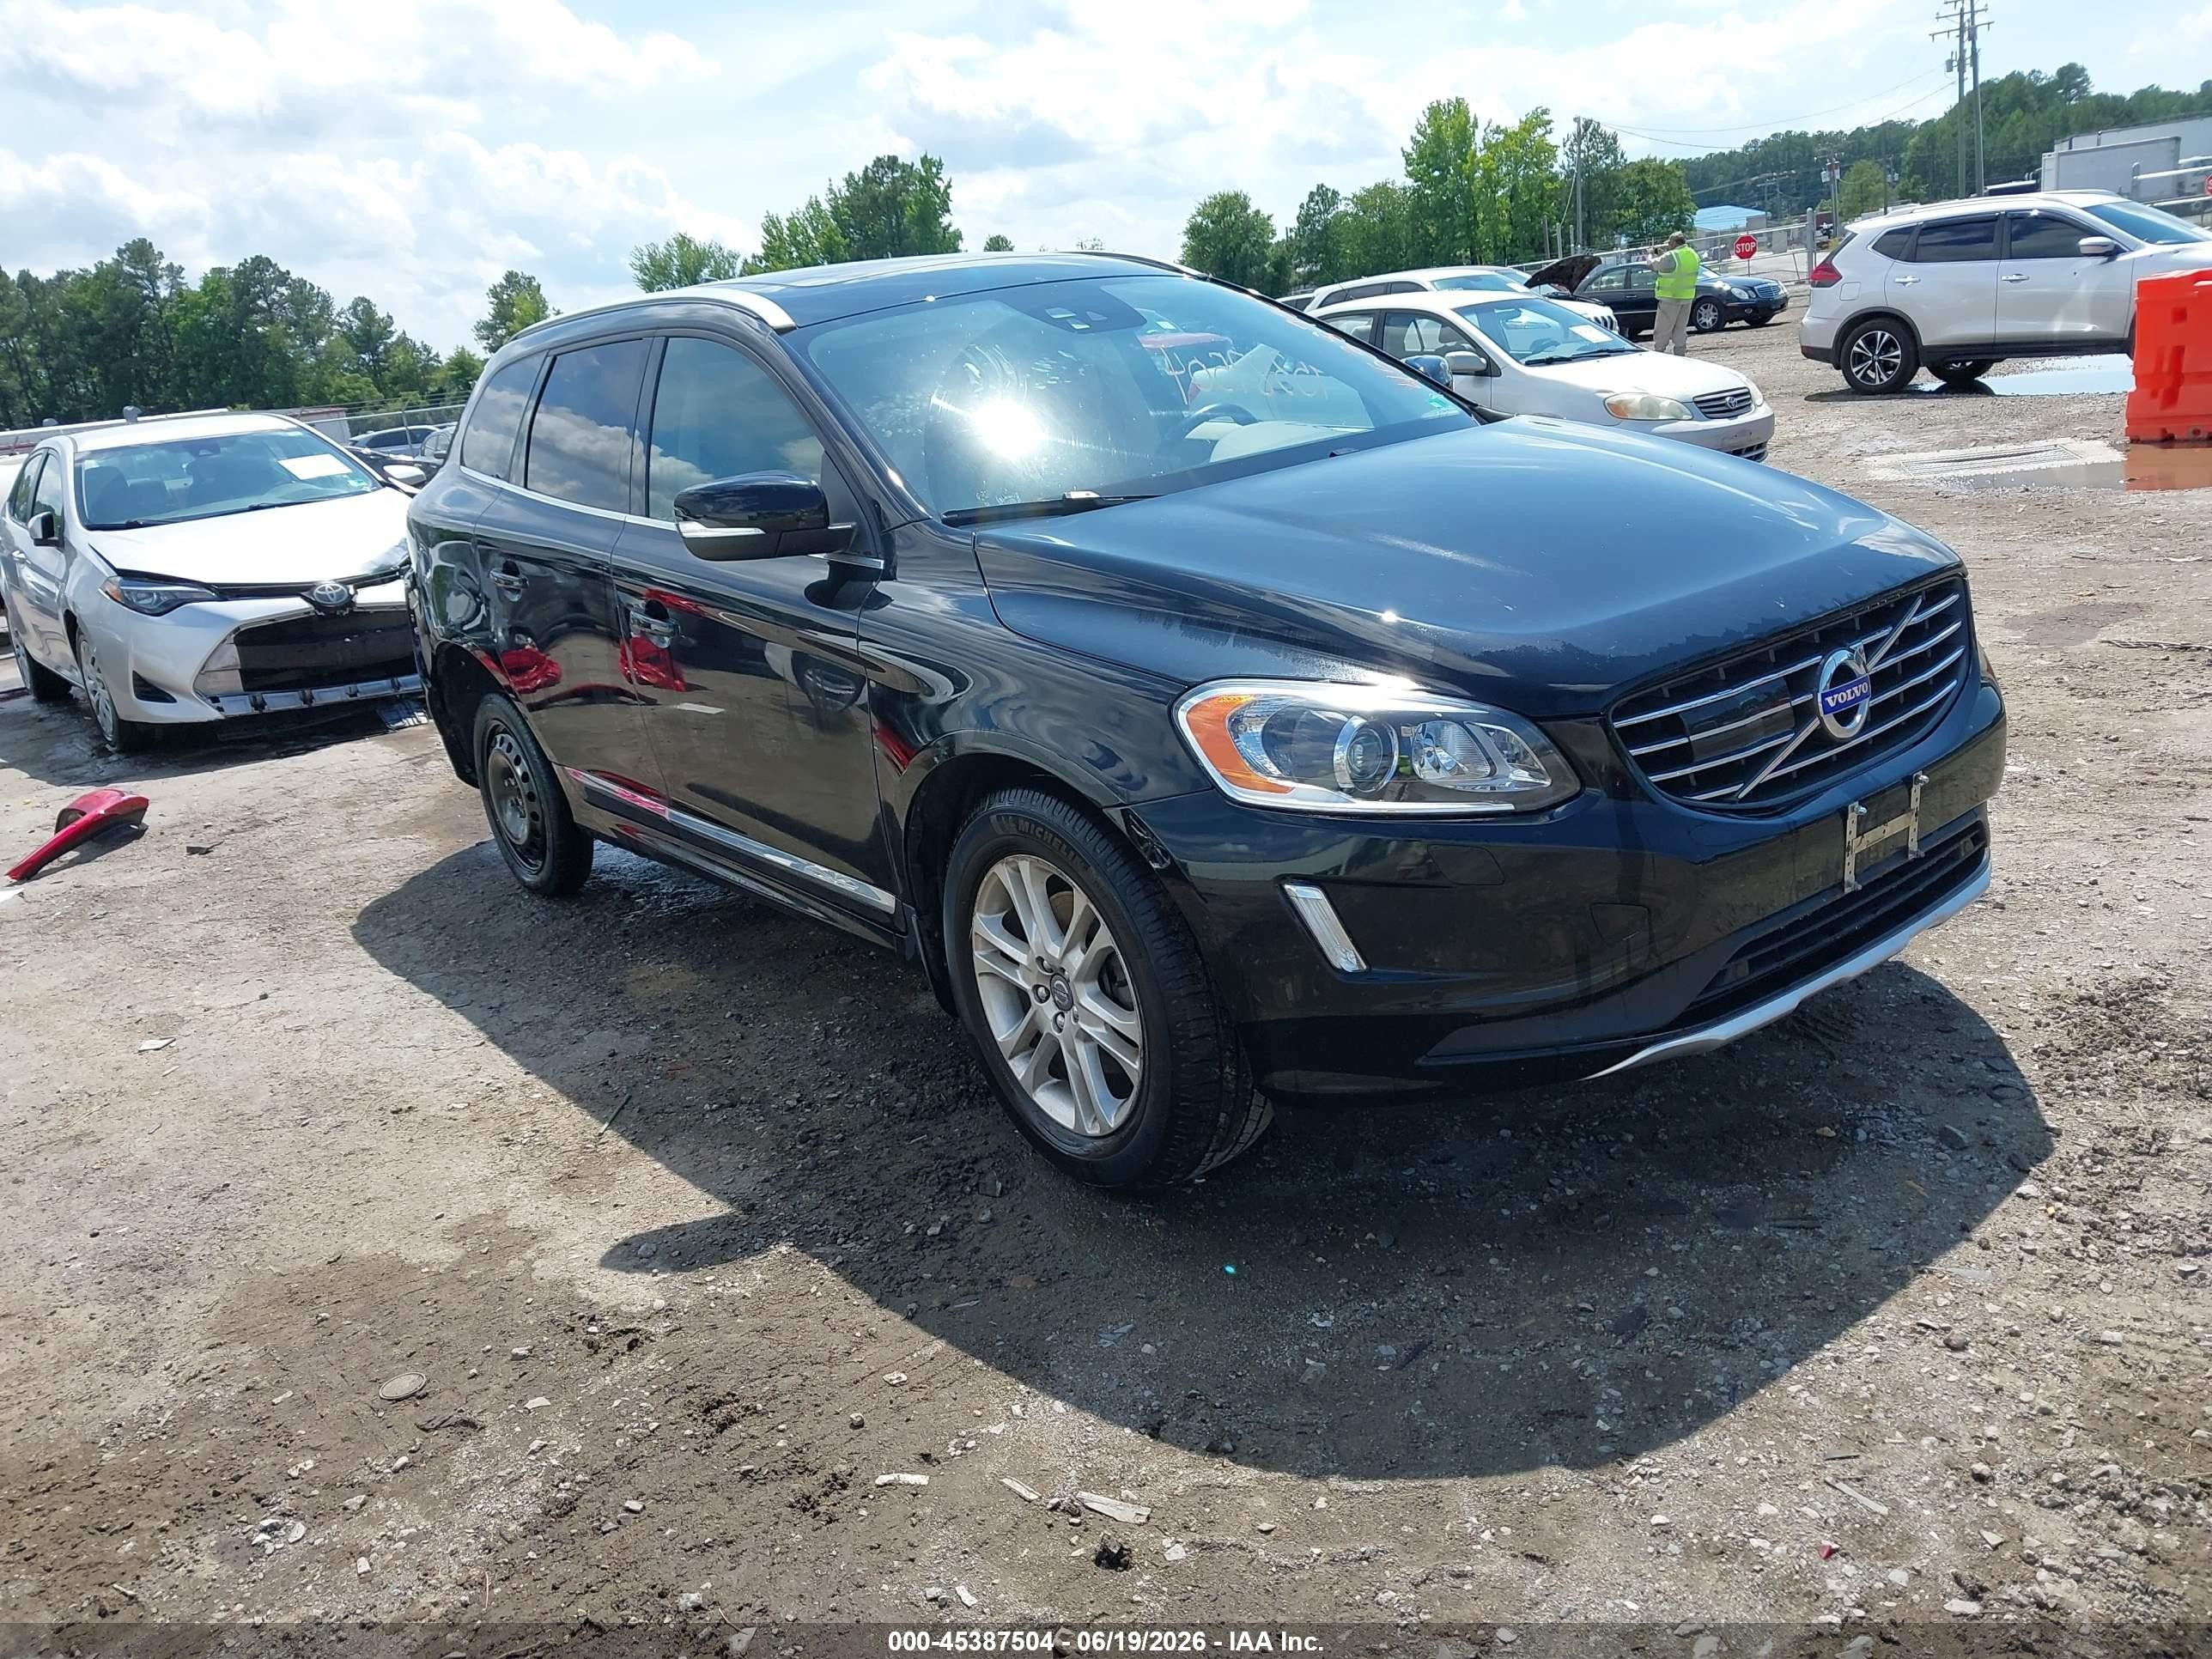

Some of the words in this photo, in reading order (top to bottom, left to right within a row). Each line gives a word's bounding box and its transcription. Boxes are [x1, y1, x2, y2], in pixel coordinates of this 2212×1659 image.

[1735, 241, 1756, 254] STOP
[1825, 682, 1869, 708] VOLVO
[1017, 818, 1091, 872] MICHELIN
